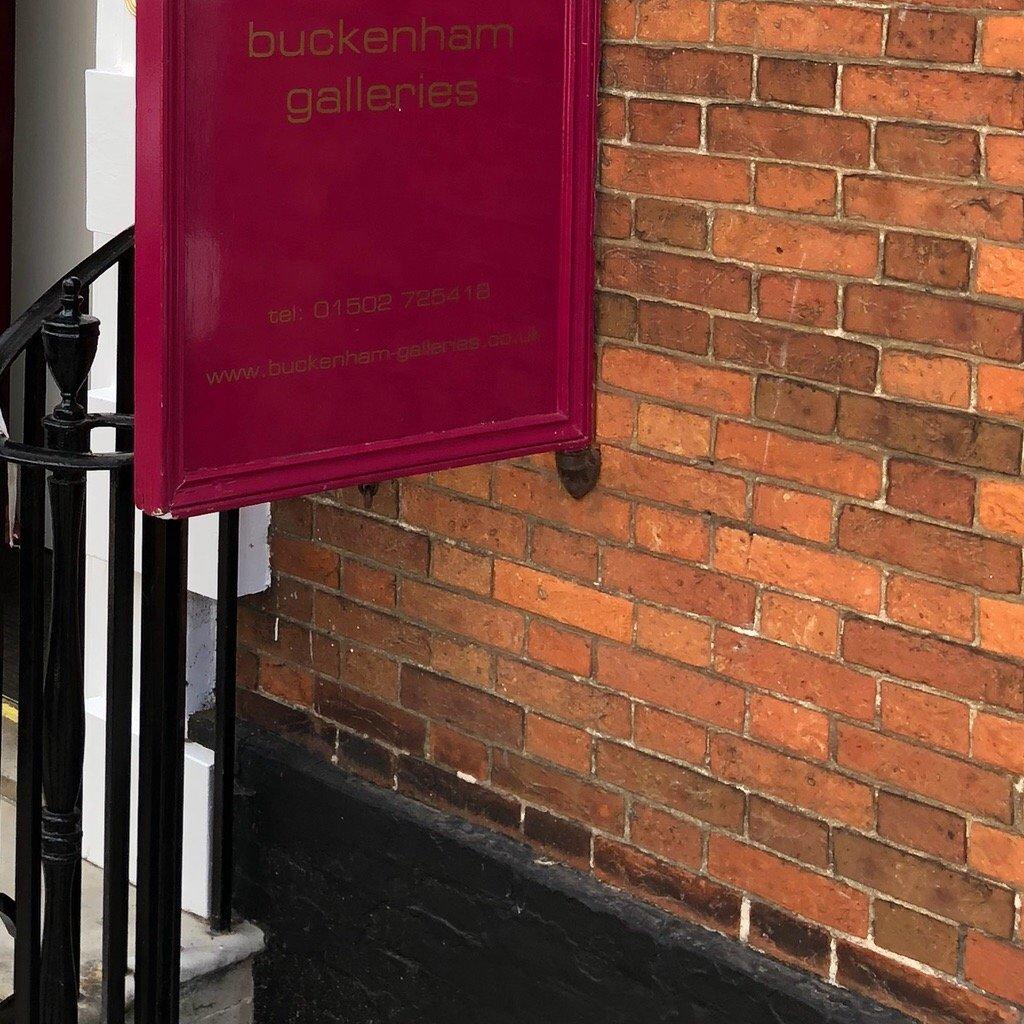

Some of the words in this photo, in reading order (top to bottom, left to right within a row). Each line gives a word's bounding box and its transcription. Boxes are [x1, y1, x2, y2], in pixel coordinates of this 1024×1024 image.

[248, 18, 514, 58] buckenham
[286, 75, 478, 124] galleries
[268, 305, 303, 325] tel:
[313, 293, 393, 319] 01502
